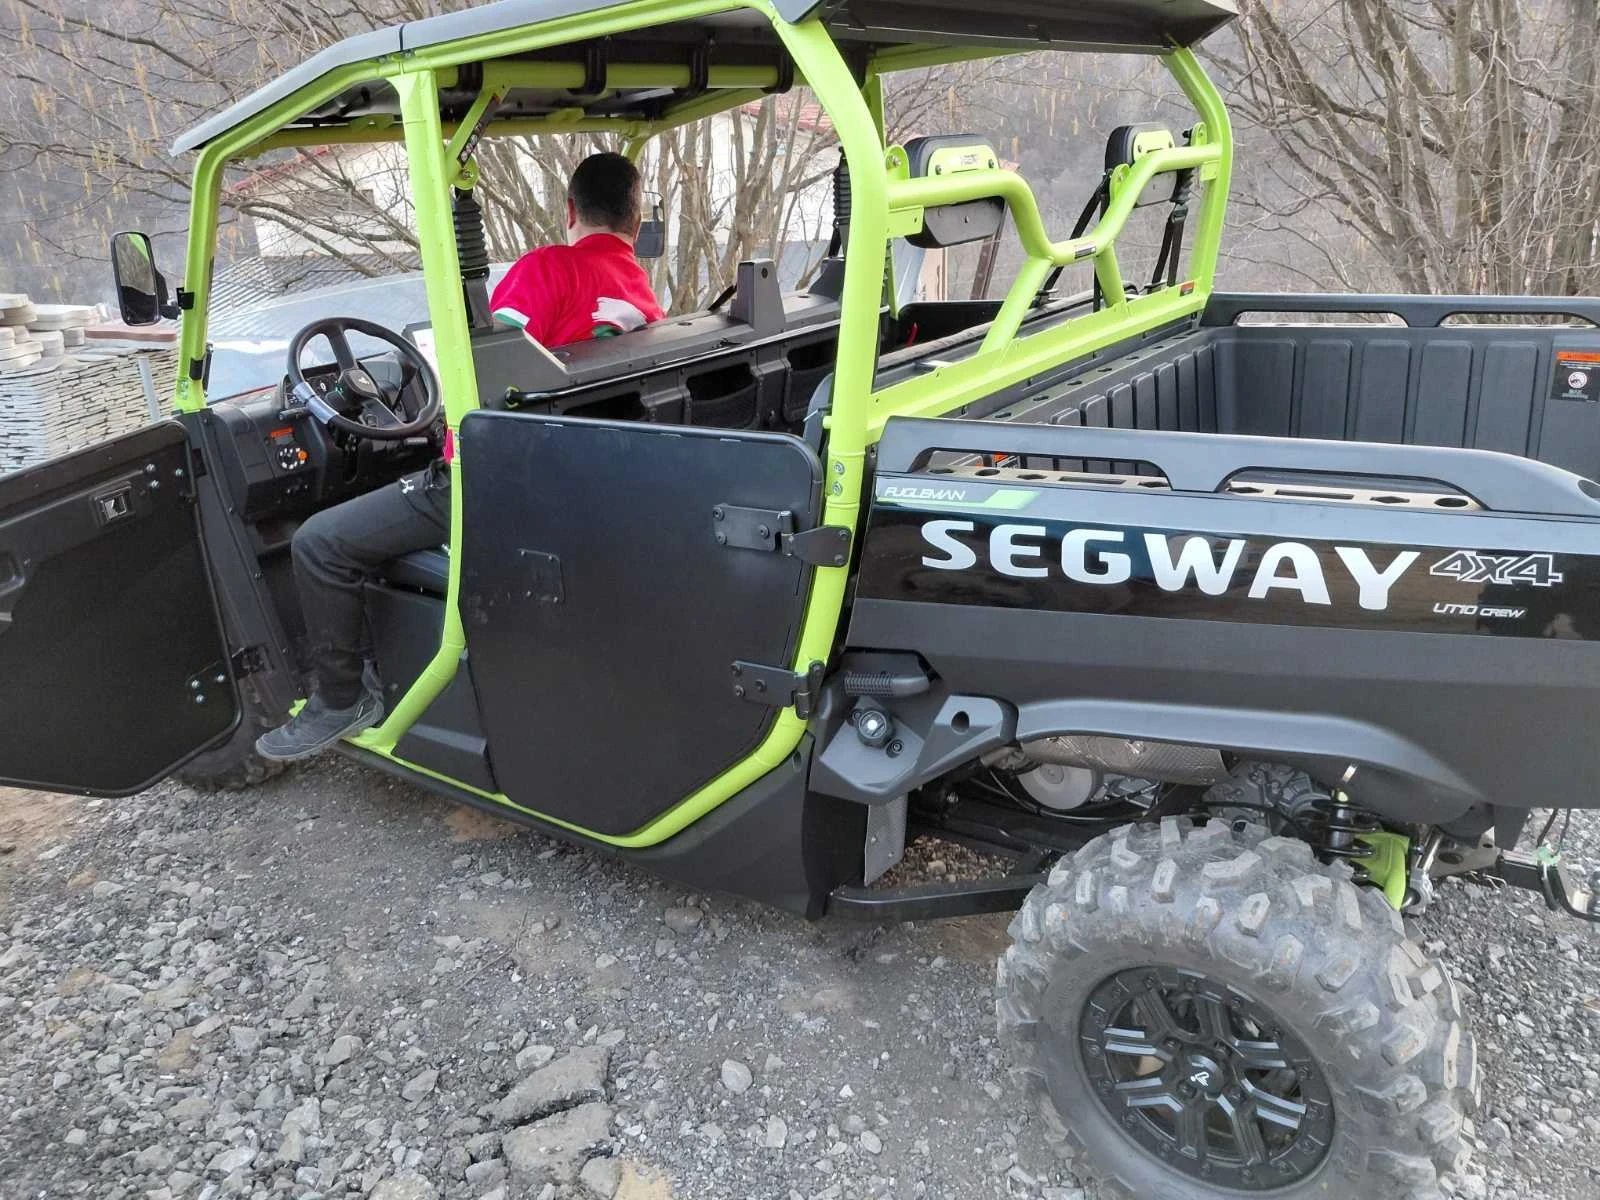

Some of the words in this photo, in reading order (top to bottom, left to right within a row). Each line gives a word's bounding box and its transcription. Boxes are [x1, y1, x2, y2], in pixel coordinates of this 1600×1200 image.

[884, 486, 966, 500] FUGLEMAN
[921, 520, 1420, 610] SEGWAY
[1479, 606, 1526, 618] CREW
